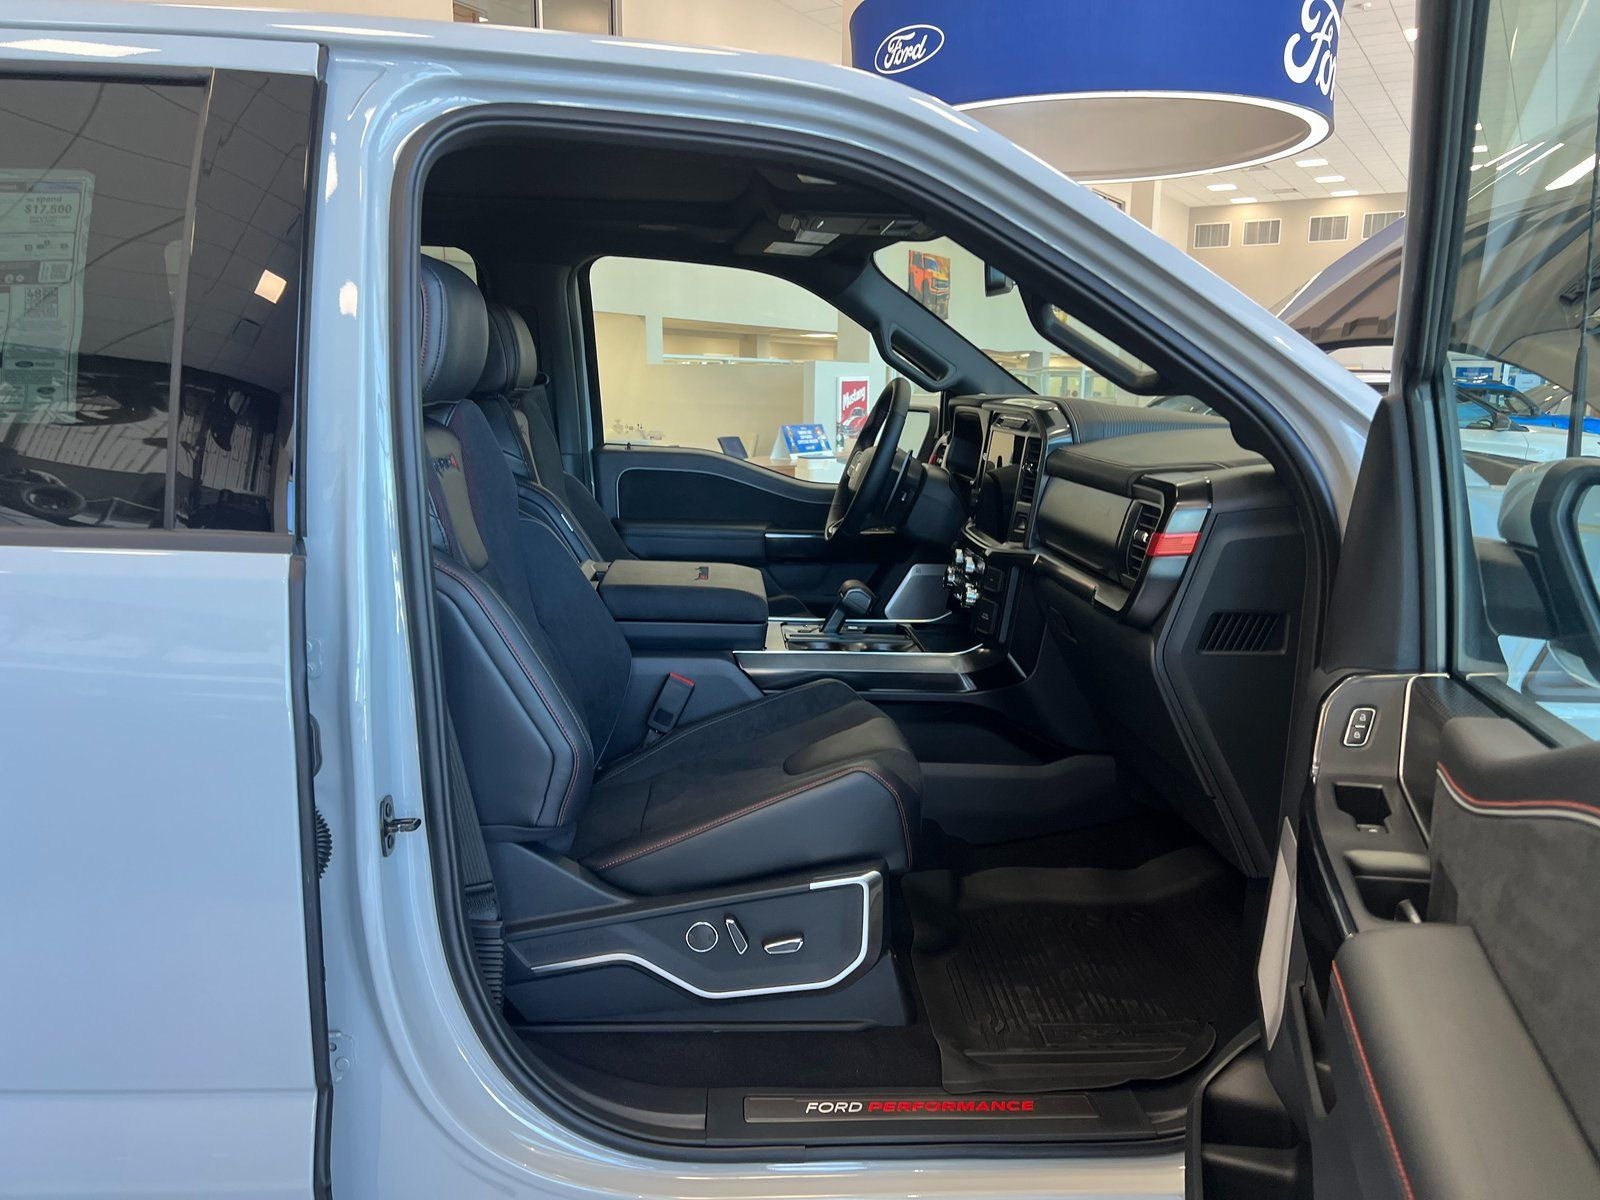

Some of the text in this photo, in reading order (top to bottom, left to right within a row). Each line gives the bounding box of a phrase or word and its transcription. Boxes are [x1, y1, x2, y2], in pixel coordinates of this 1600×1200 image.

[883, 31, 928, 69] Ford
[24, 204, 72, 214] $17,500
[842, 386, 866, 410] Mustang
[805, 1099, 1034, 1114] FORD PERFORMANCE
